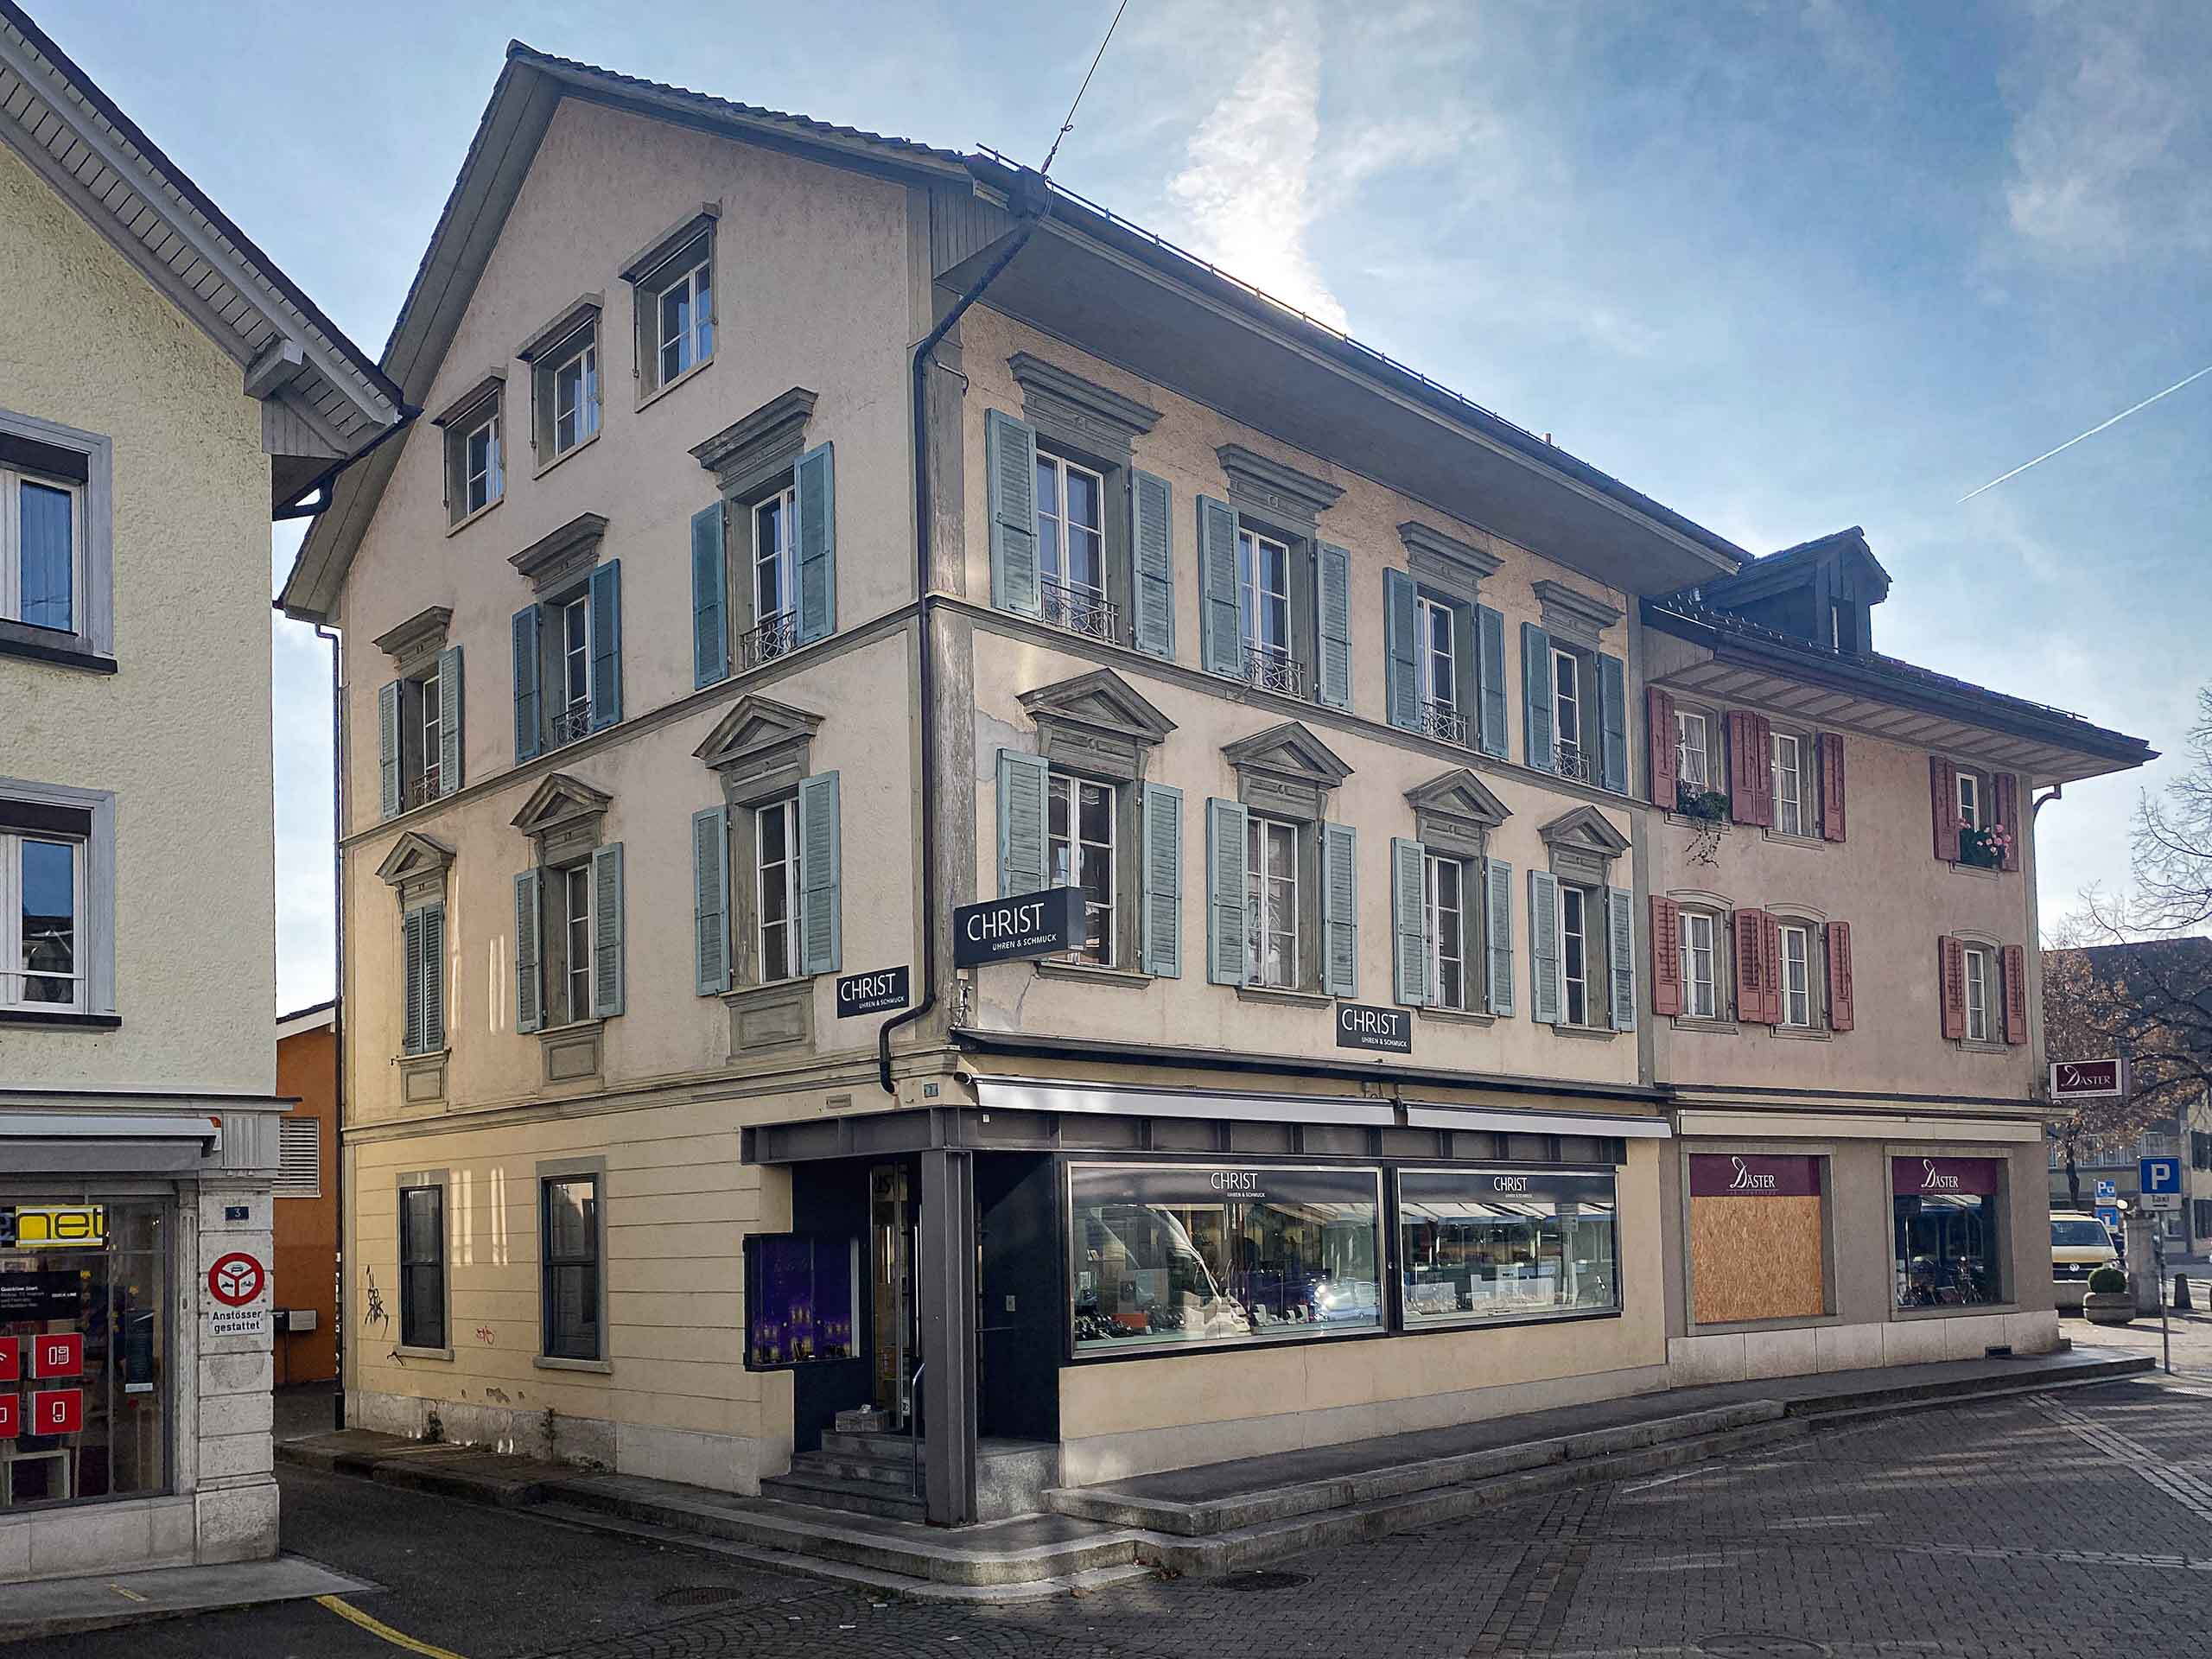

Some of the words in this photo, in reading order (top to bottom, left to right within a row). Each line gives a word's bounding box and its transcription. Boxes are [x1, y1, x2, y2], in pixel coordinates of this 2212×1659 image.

[967, 902, 1045, 942] CHRIST
[992, 940, 1015, 951] UHREN
[1016, 939, 1022, 948] &
[1023, 933, 1058, 946] SCHMUCK
[841, 973, 896, 1001] CHRIST
[1342, 1008, 1399, 1036] CHRIST
[1211, 1173, 1259, 1190] CHRIST
[1493, 1176, 1528, 1192] CHRIST
[2151, 1163, 2171, 1190] P
[234, 1208, 241, 1217] 3
[213, 1310, 262, 1321] Anstösser
[214, 1321, 260, 1334] gestattet
